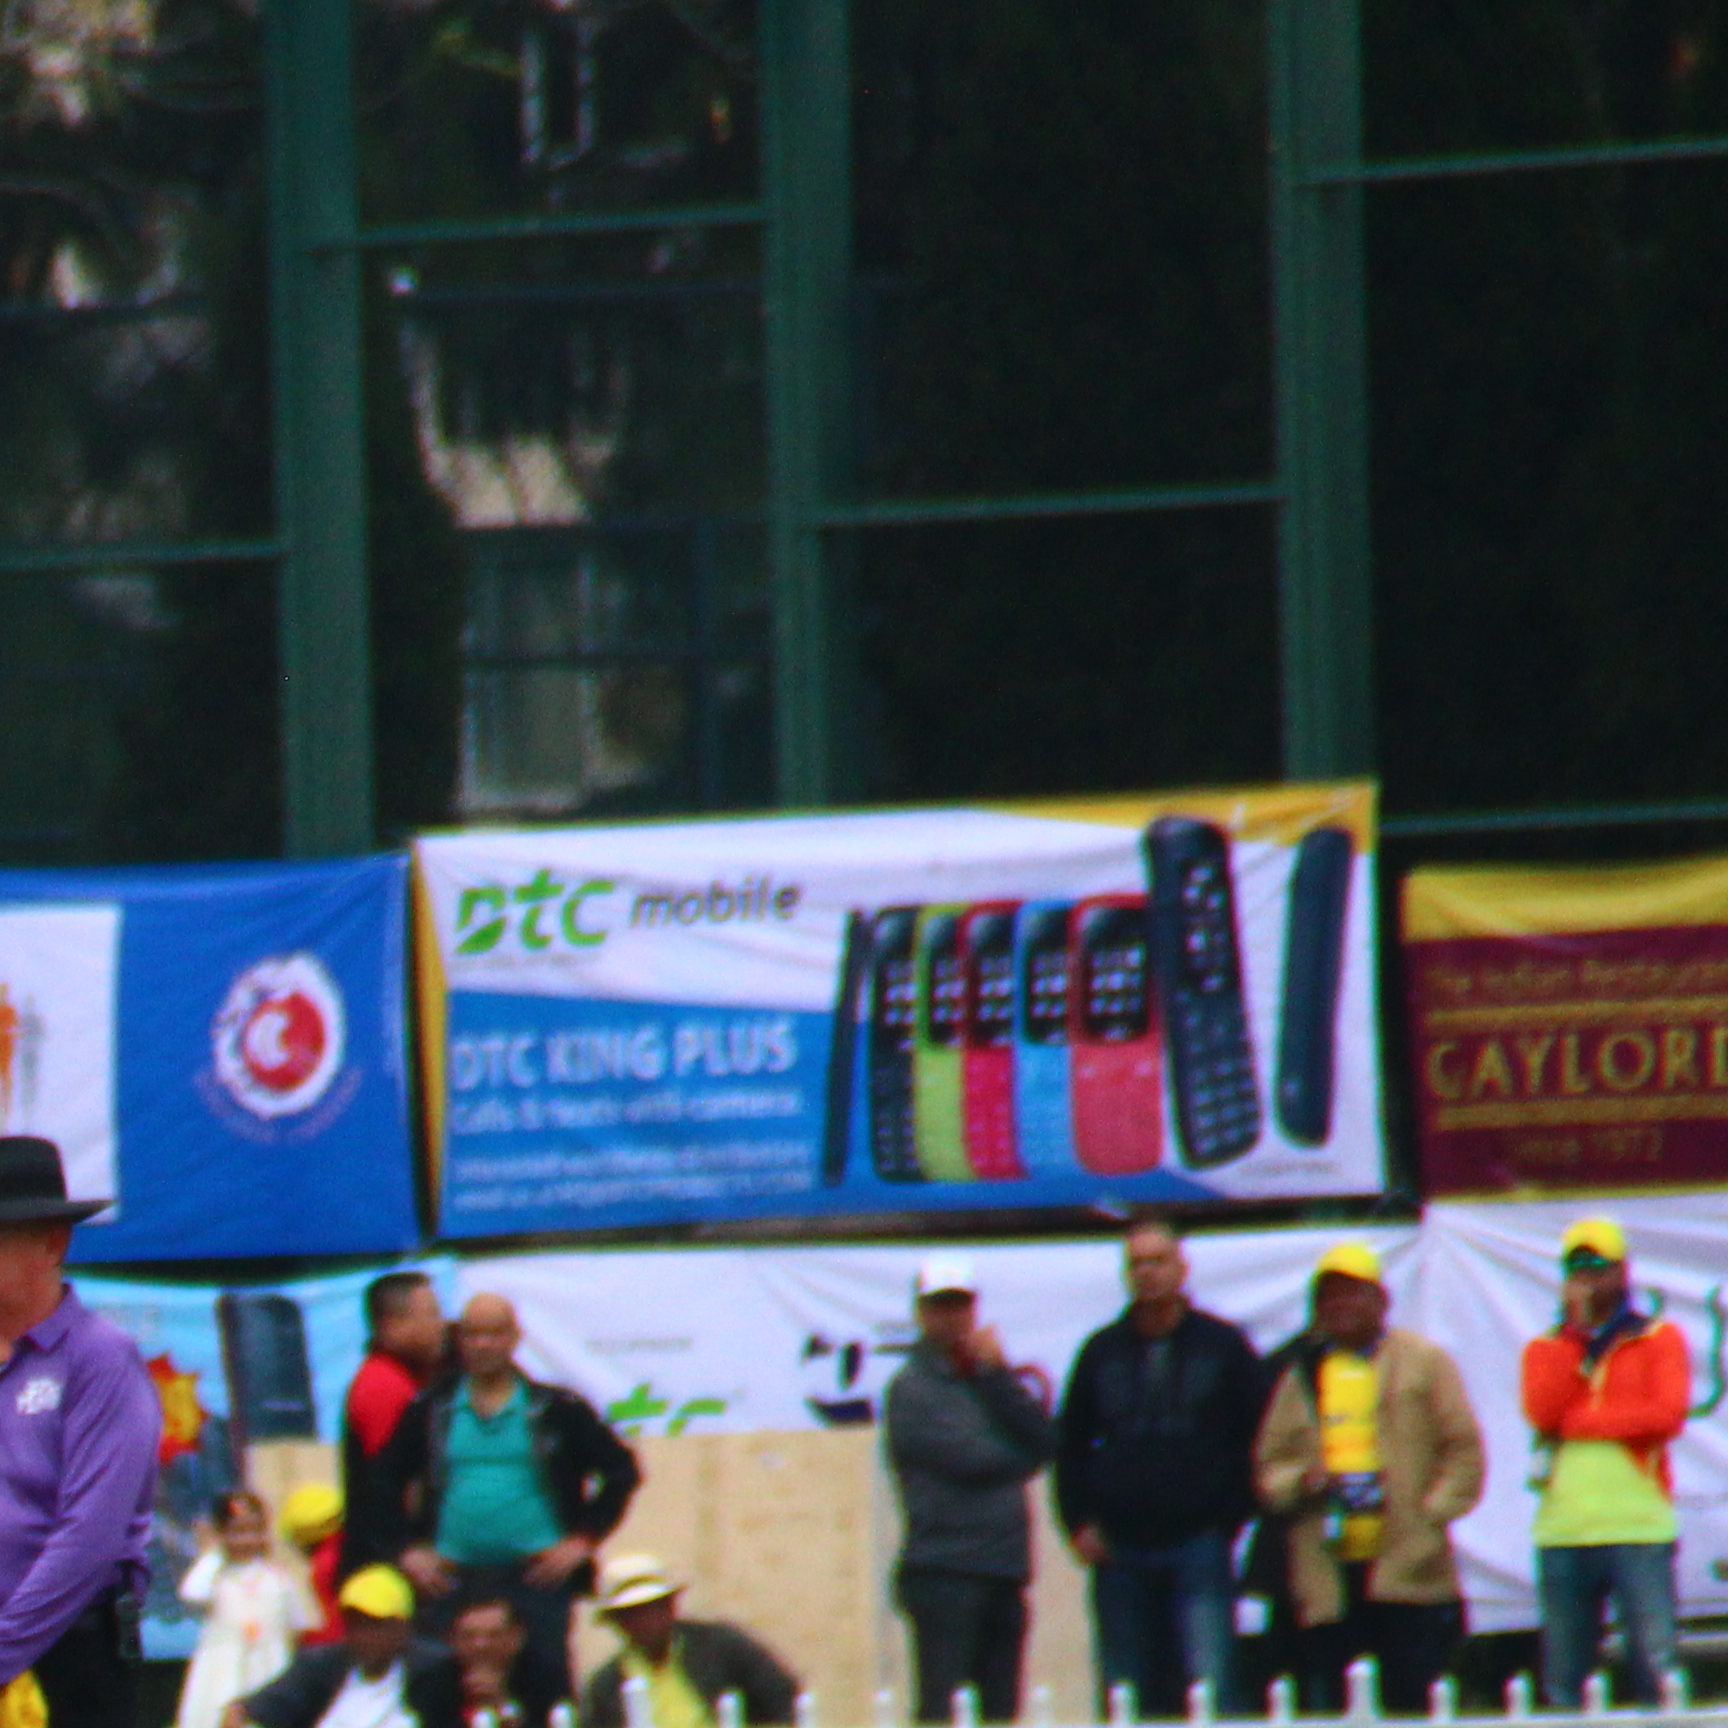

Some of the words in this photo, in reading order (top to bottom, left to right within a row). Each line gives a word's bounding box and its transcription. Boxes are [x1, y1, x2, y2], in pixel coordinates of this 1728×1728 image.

[630, 875, 804, 928] mobile
[450, 1035, 537, 1091] DTC
[546, 1025, 664, 1083] KING
[673, 1016, 799, 1078] PLUS
